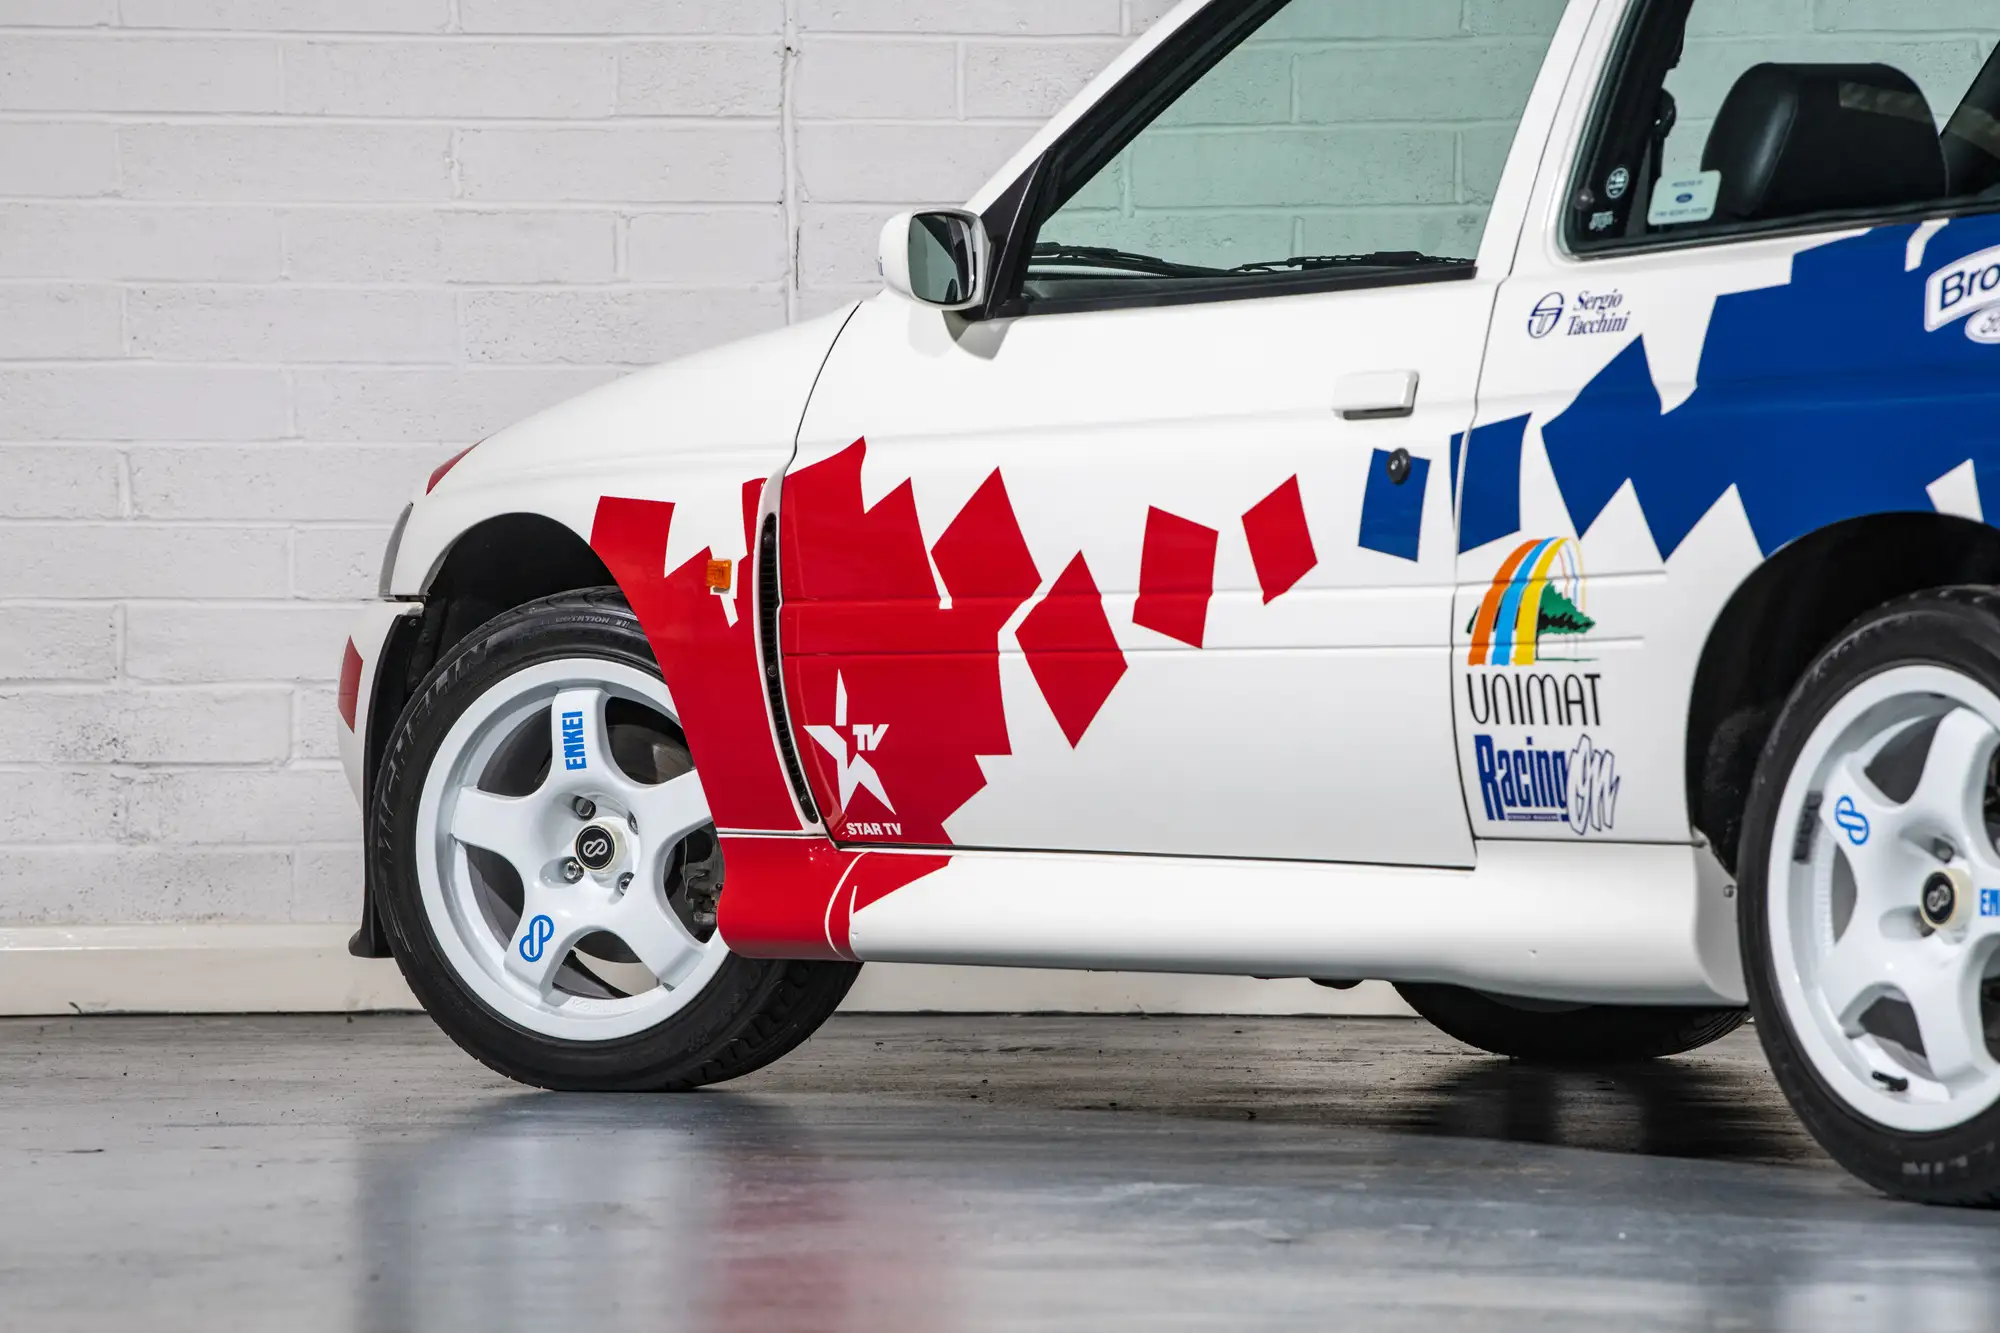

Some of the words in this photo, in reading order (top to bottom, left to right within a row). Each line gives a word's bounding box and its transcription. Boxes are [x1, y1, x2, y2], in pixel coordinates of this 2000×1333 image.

[1573, 288, 1623, 314] Sergio
[1566, 310, 1631, 336] Tacchini
[1466, 673, 1601, 726] UNIMAT
[562, 711, 587, 770] ENKEI
[852, 724, 889, 751] TV
[1474, 734, 1571, 821] Racing
[846, 822, 881, 836] STAR
[883, 822, 902, 836] TV
